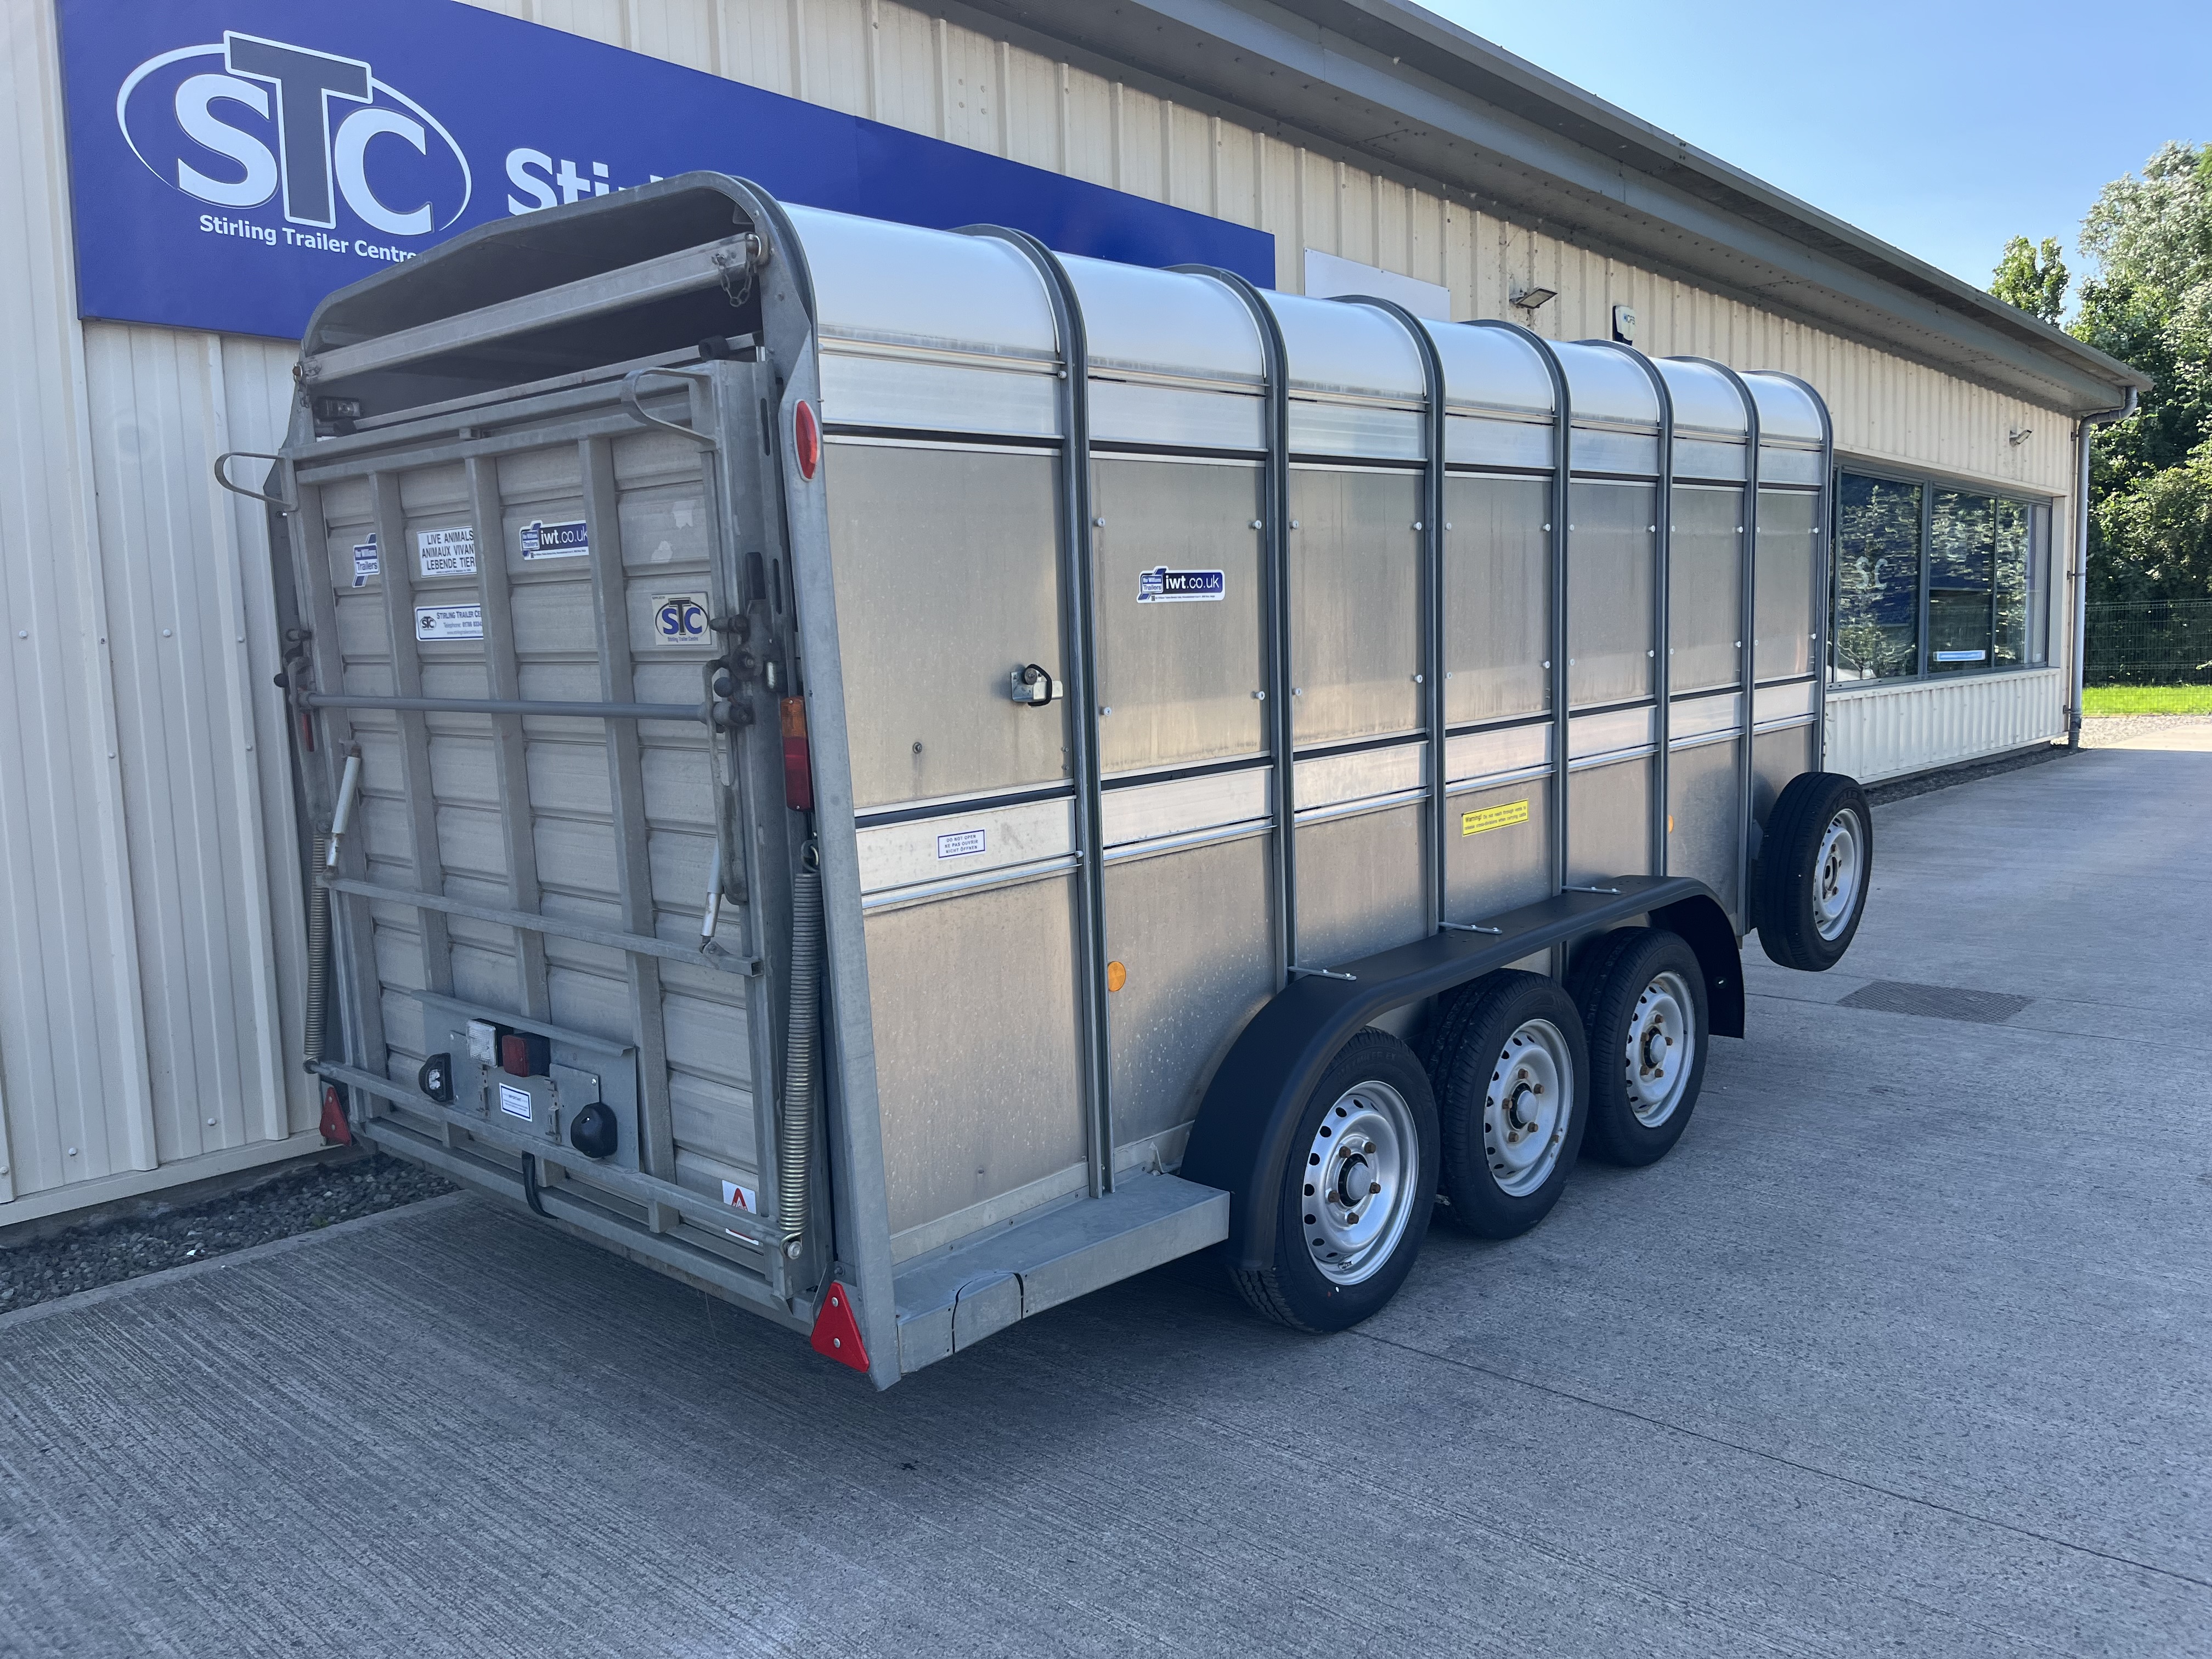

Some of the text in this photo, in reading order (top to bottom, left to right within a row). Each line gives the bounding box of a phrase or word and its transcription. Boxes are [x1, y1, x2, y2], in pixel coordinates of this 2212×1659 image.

[174, 31, 433, 236] STC
[200, 215, 276, 246] Stirling
[282, 227, 349, 253] Trailer
[427, 530, 473, 545] LIVE ANIMALS
[540, 526, 588, 545] iwt.co.uk
[422, 546, 451, 558] ANIMAUX
[356, 561, 377, 571] Trailers
[427, 558, 457, 571] LEBENDE
[1166, 574, 1220, 589] iwt.co.uk
[421, 616, 435, 629] STC
[662, 597, 703, 635] STC
[1465, 814, 1482, 823] Warning!
